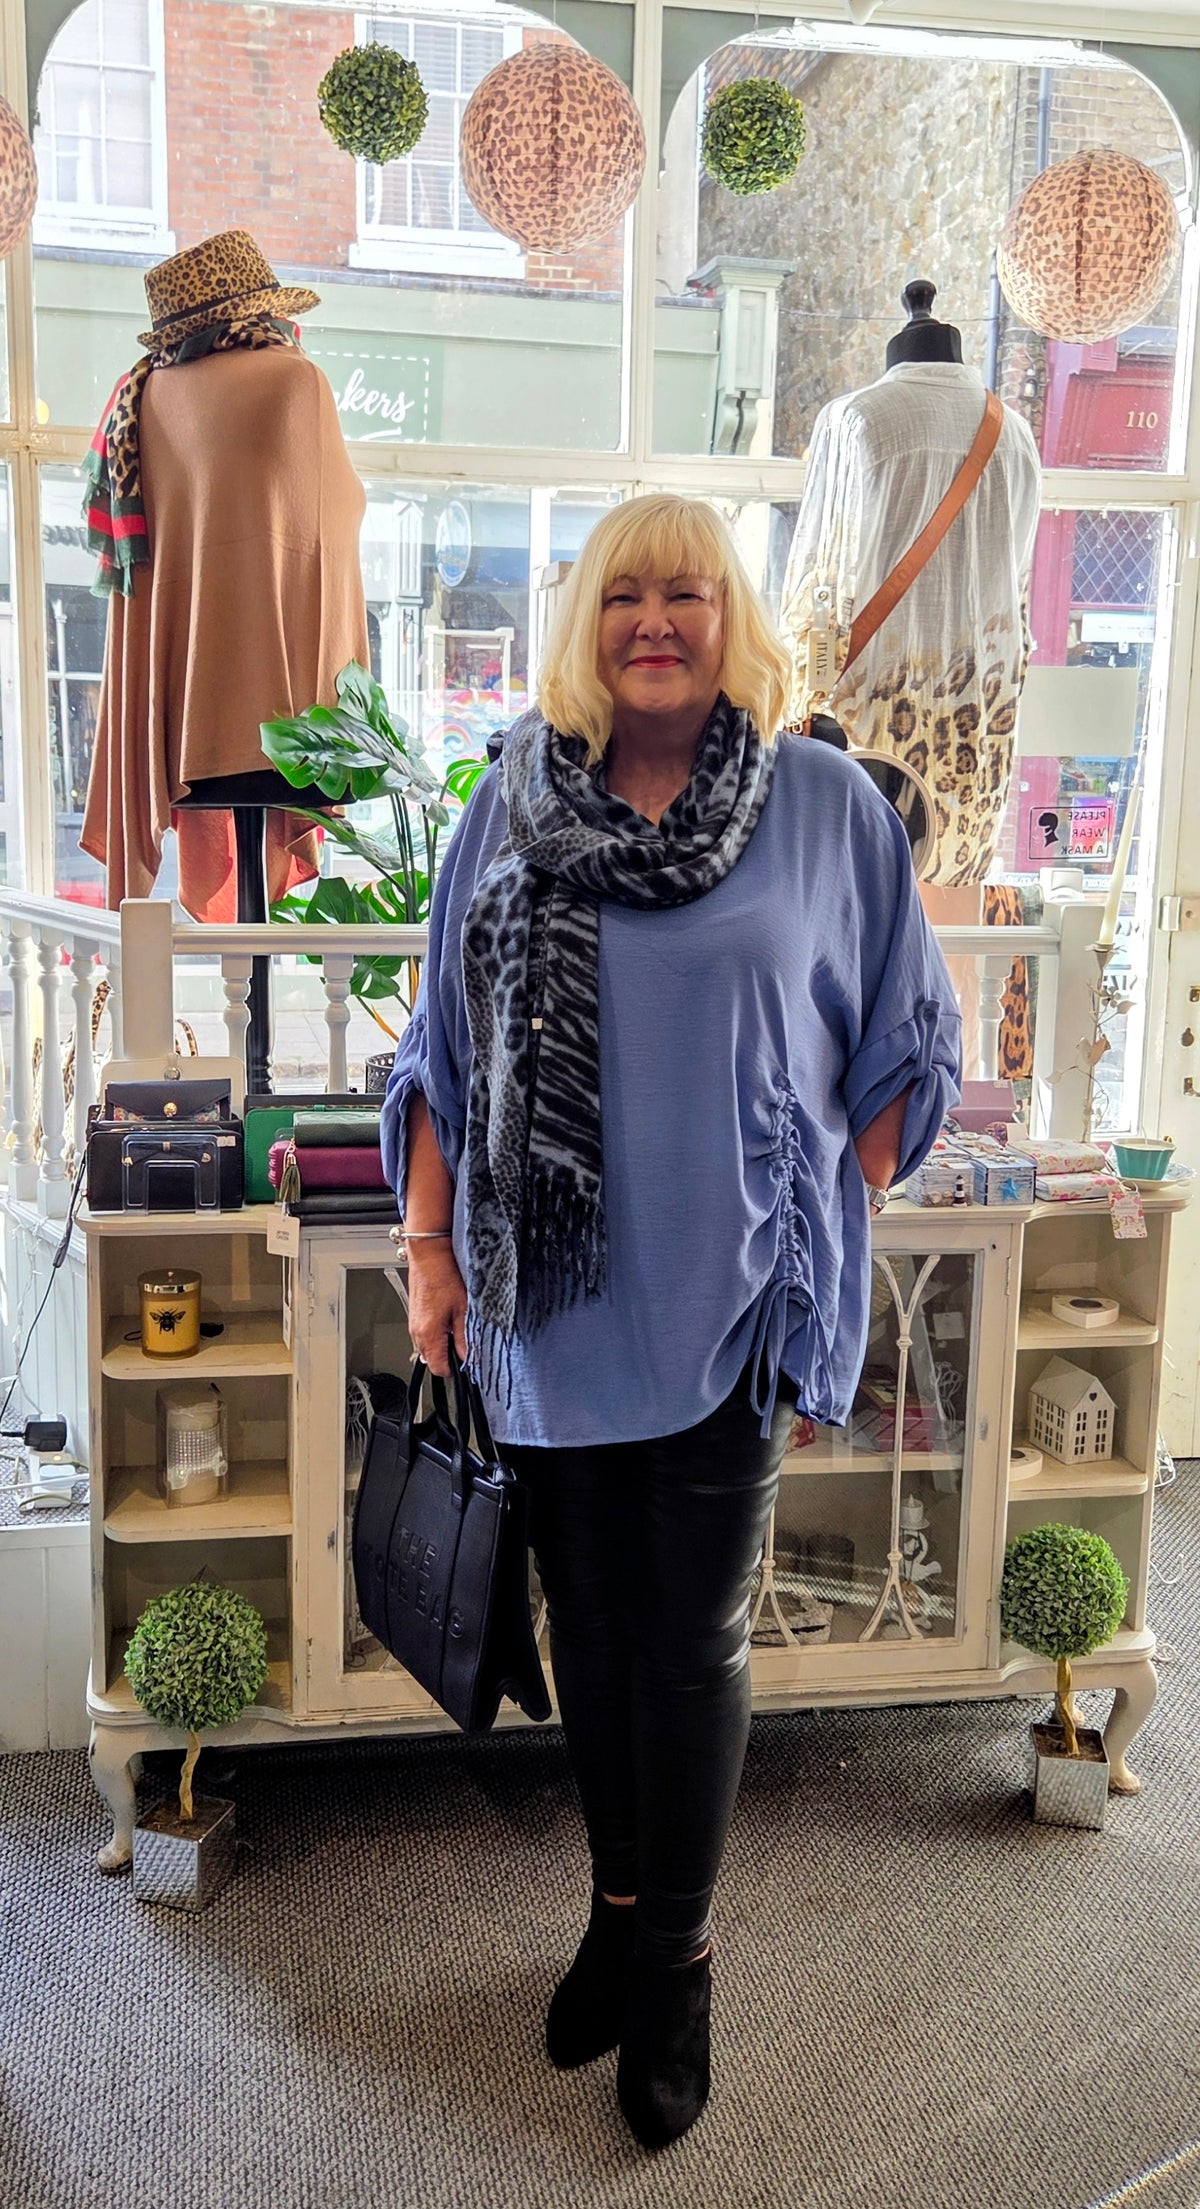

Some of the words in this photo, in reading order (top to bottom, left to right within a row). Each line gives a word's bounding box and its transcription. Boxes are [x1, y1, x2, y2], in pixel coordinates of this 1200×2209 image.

[1125, 410, 1159, 429] 110
[816, 642, 828, 670] ITALY
[399, 1525, 438, 1579] THE
